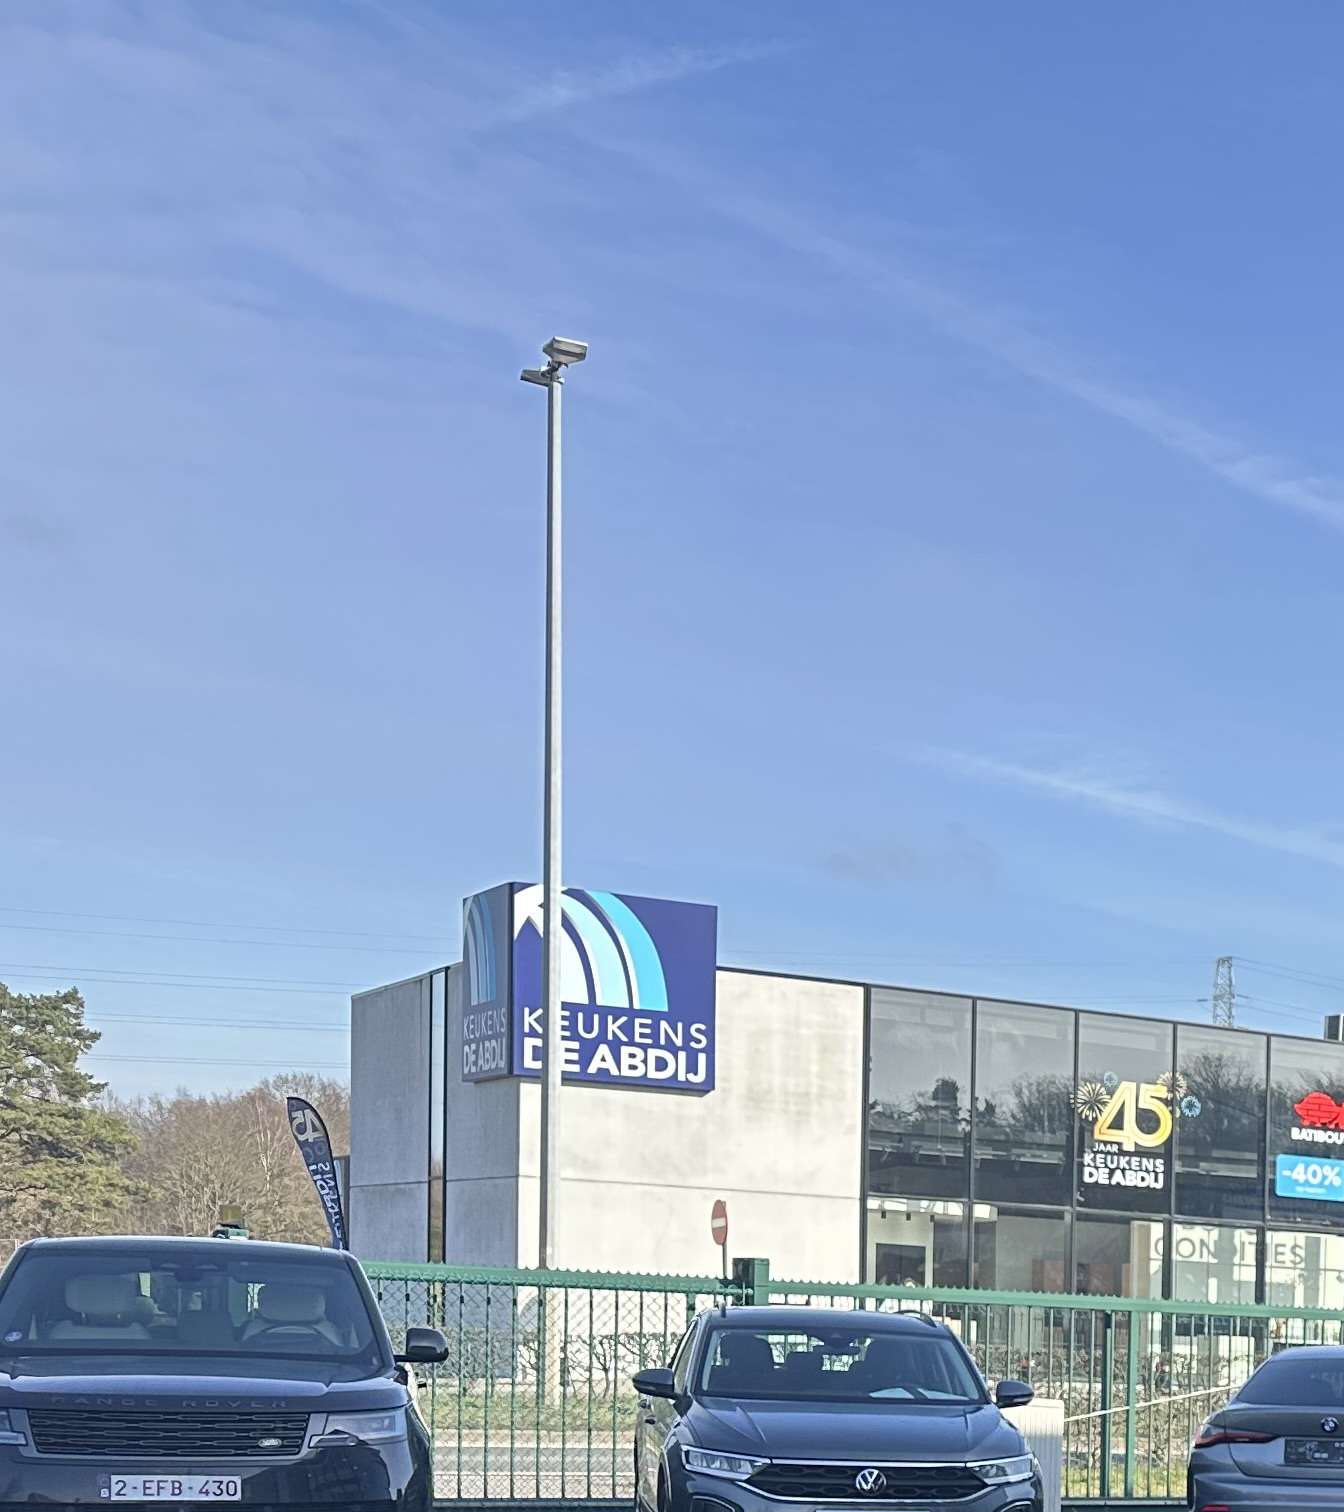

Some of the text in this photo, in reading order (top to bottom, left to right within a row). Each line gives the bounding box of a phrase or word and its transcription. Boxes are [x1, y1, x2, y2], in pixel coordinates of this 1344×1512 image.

[463, 1008, 506, 1041] KEUKENS
[463, 1036, 506, 1074] DE ABDIJ
[523, 1036, 707, 1084] DE ABDIJ
[1094, 1081, 1173, 1151] 45
[1093, 1142, 1119, 1153] JAAR
[1083, 1152, 1164, 1172] KEUKENS
[1083, 1166, 1109, 1184] DE
[1281, 1163, 1342, 1187] -40%
[114, 1479, 239, 1498] 2-EFB-430
